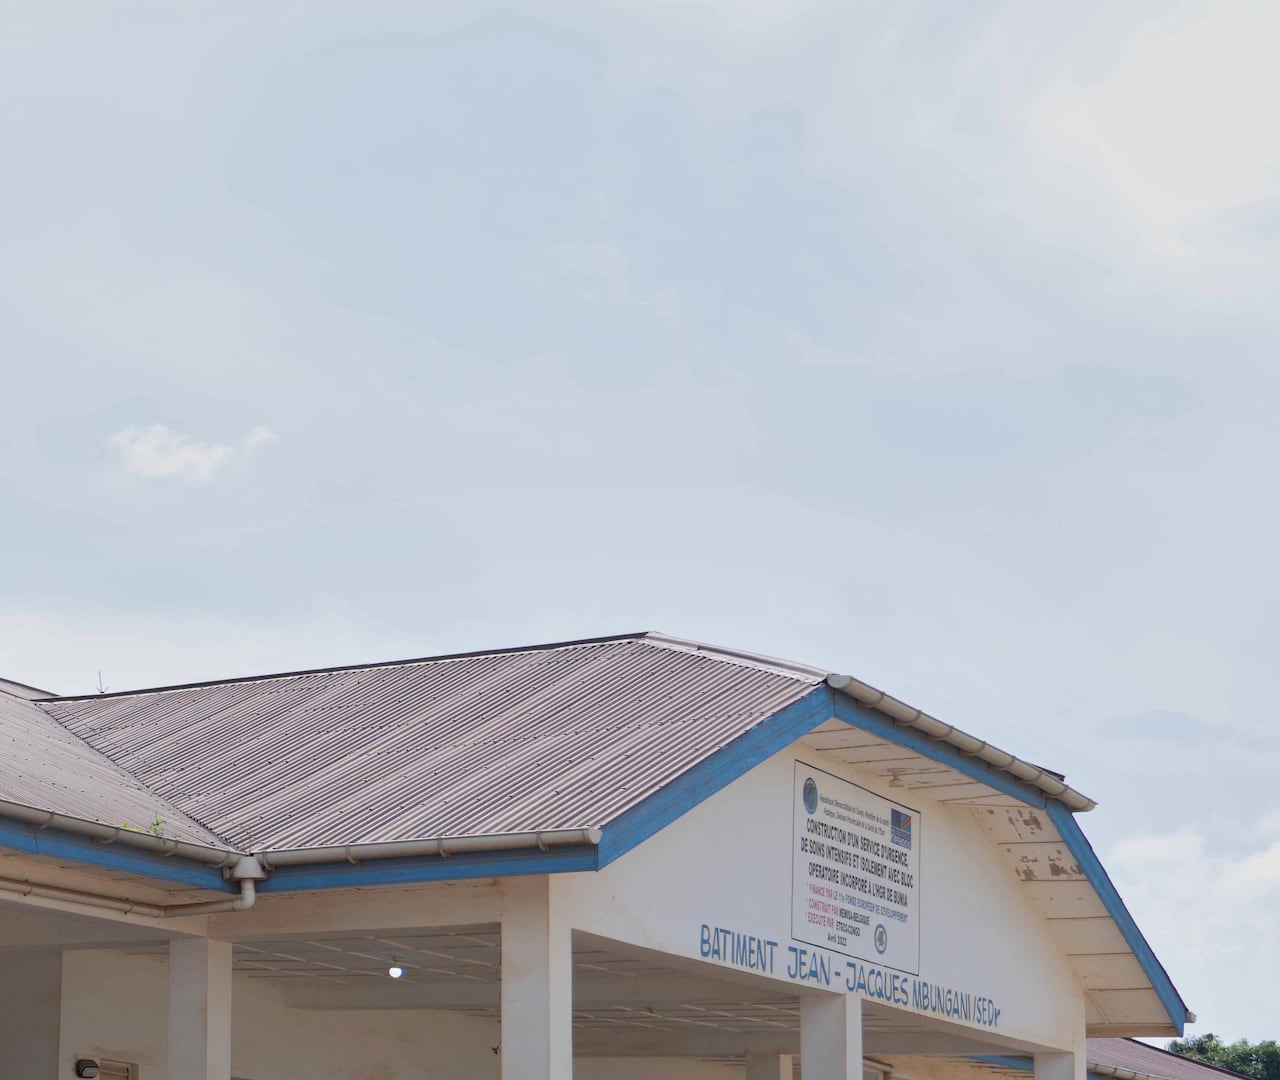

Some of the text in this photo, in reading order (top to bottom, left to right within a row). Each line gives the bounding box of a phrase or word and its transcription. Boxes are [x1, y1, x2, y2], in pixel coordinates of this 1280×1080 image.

[807, 818, 847, 844] CONSTRUCTION
[860, 836, 880, 857] SERVICE
[801, 837, 914, 889] DE SOINS INTENSIFS ET ISOLEMENT AVEC BLOC
[886, 886, 893, 902] DE
[893, 889, 908, 907] BUNIA
[700, 923, 778, 974] BATIMENT
[787, 946, 831, 986] JEAN
[846, 961, 909, 1006] JACQUES
